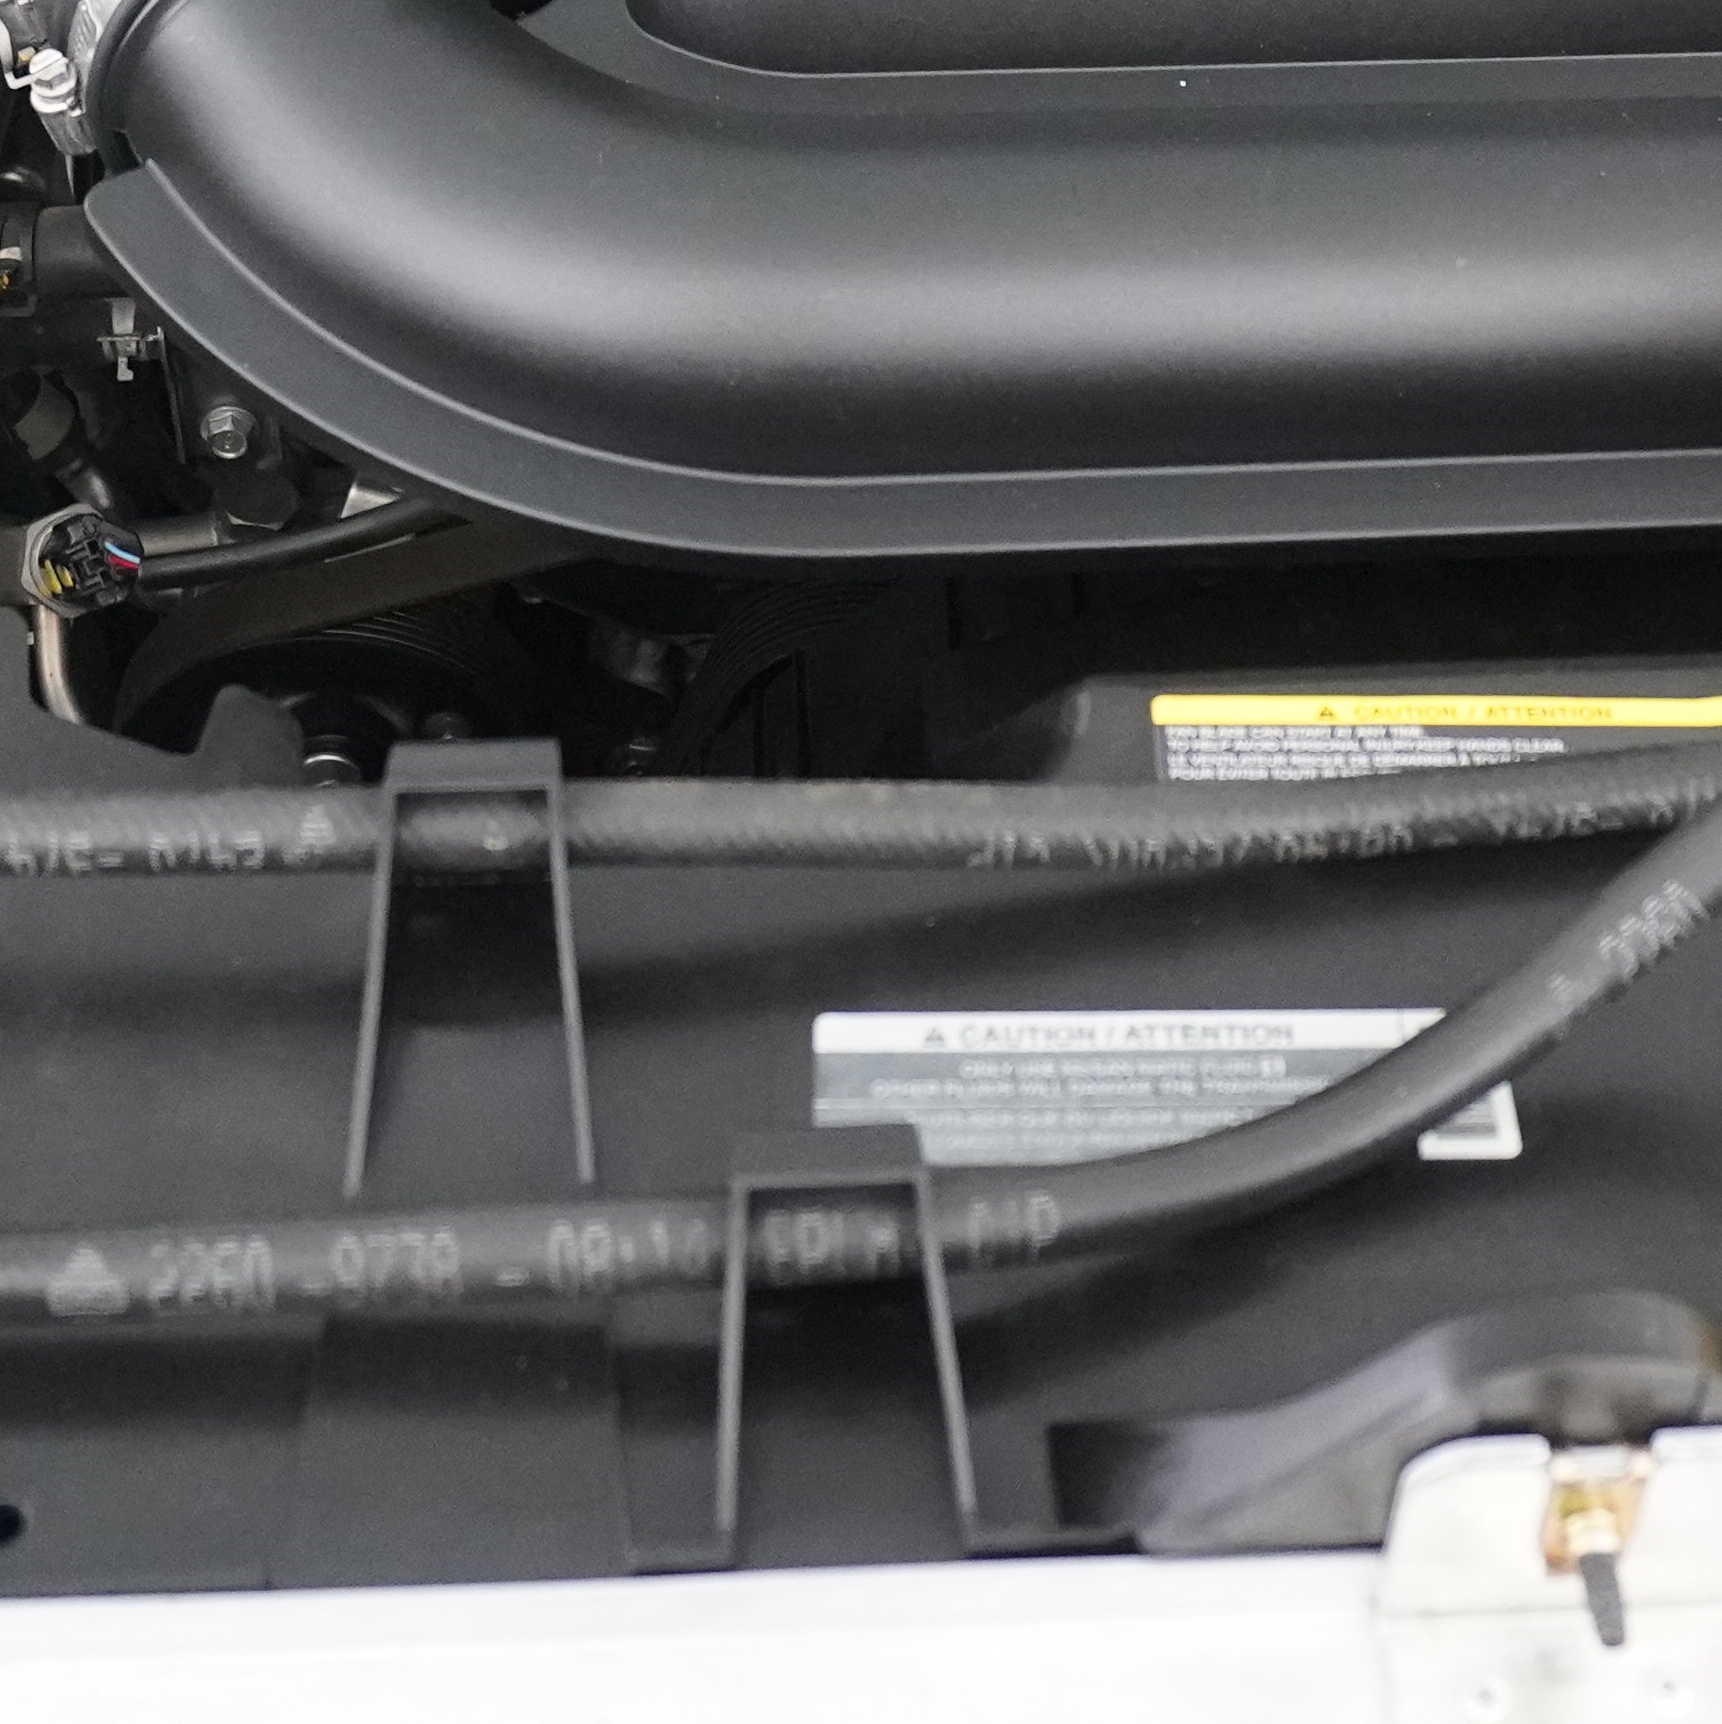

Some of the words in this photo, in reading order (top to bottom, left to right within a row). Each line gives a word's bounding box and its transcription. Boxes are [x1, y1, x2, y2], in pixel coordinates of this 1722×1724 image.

[1353, 705, 1458, 721] CAUTION
[1486, 705, 1612, 721] ATTENTION
[959, 1025, 1096, 1048] CAUTION
[1126, 1023, 1295, 1046] ATTENTION
